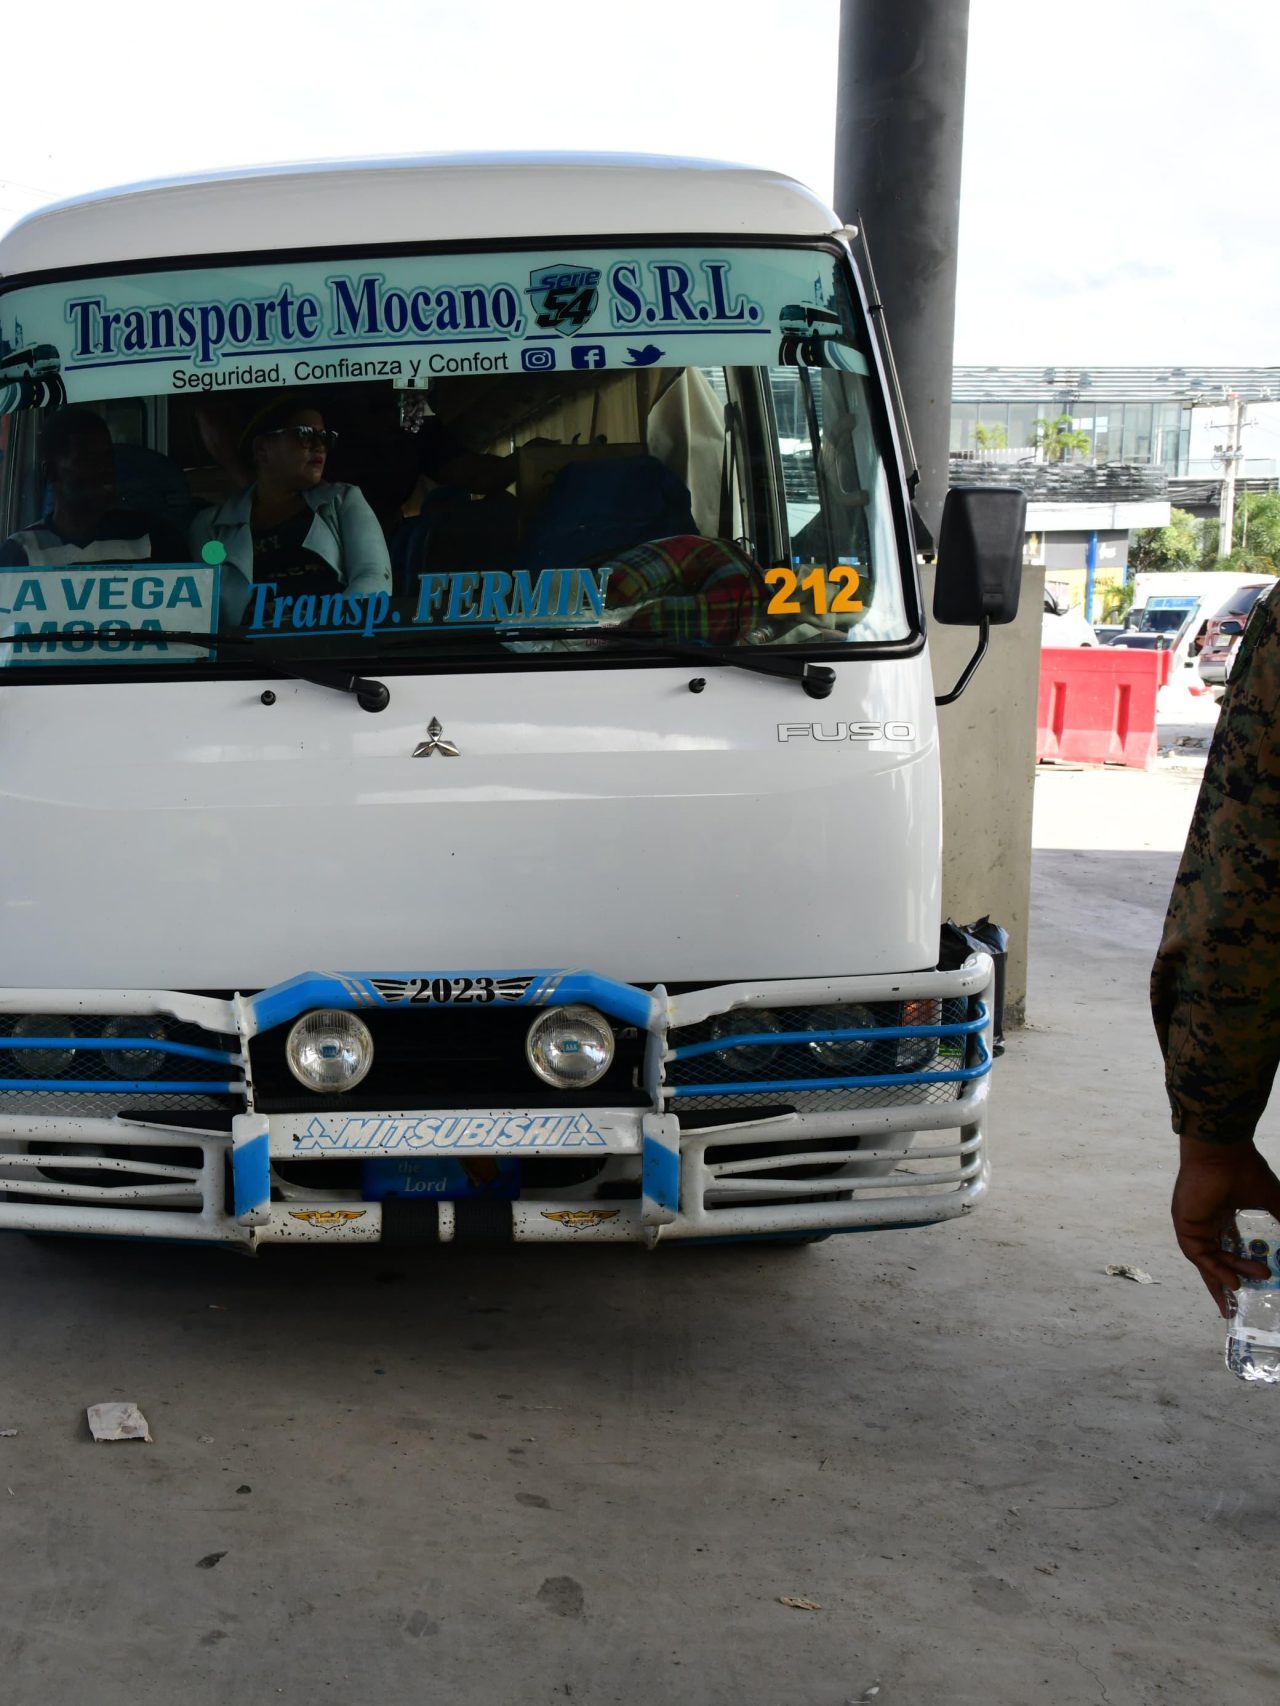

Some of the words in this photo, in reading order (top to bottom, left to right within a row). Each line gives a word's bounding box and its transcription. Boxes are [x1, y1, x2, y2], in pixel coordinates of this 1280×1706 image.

[70, 286, 318, 362] Transporte
[331, 277, 522, 337] Mocano,
[612, 264, 759, 323] S.R.L.
[536, 288, 594, 328] 54
[172, 364, 286, 392] Seguridad,
[294, 357, 402, 381] Confianza
[410, 358, 421, 378] y
[428, 351, 509, 374] Confort
[60, 575, 203, 611] VEGA
[247, 582, 401, 637] Transp.
[412, 567, 613, 623] FERMIN
[763, 565, 864, 615] 212
[776, 720, 916, 743] FUSO
[410, 977, 497, 1004] 2023
[333, 1115, 575, 1150] MITSUBISHI
[403, 1176, 448, 1193] Lord
